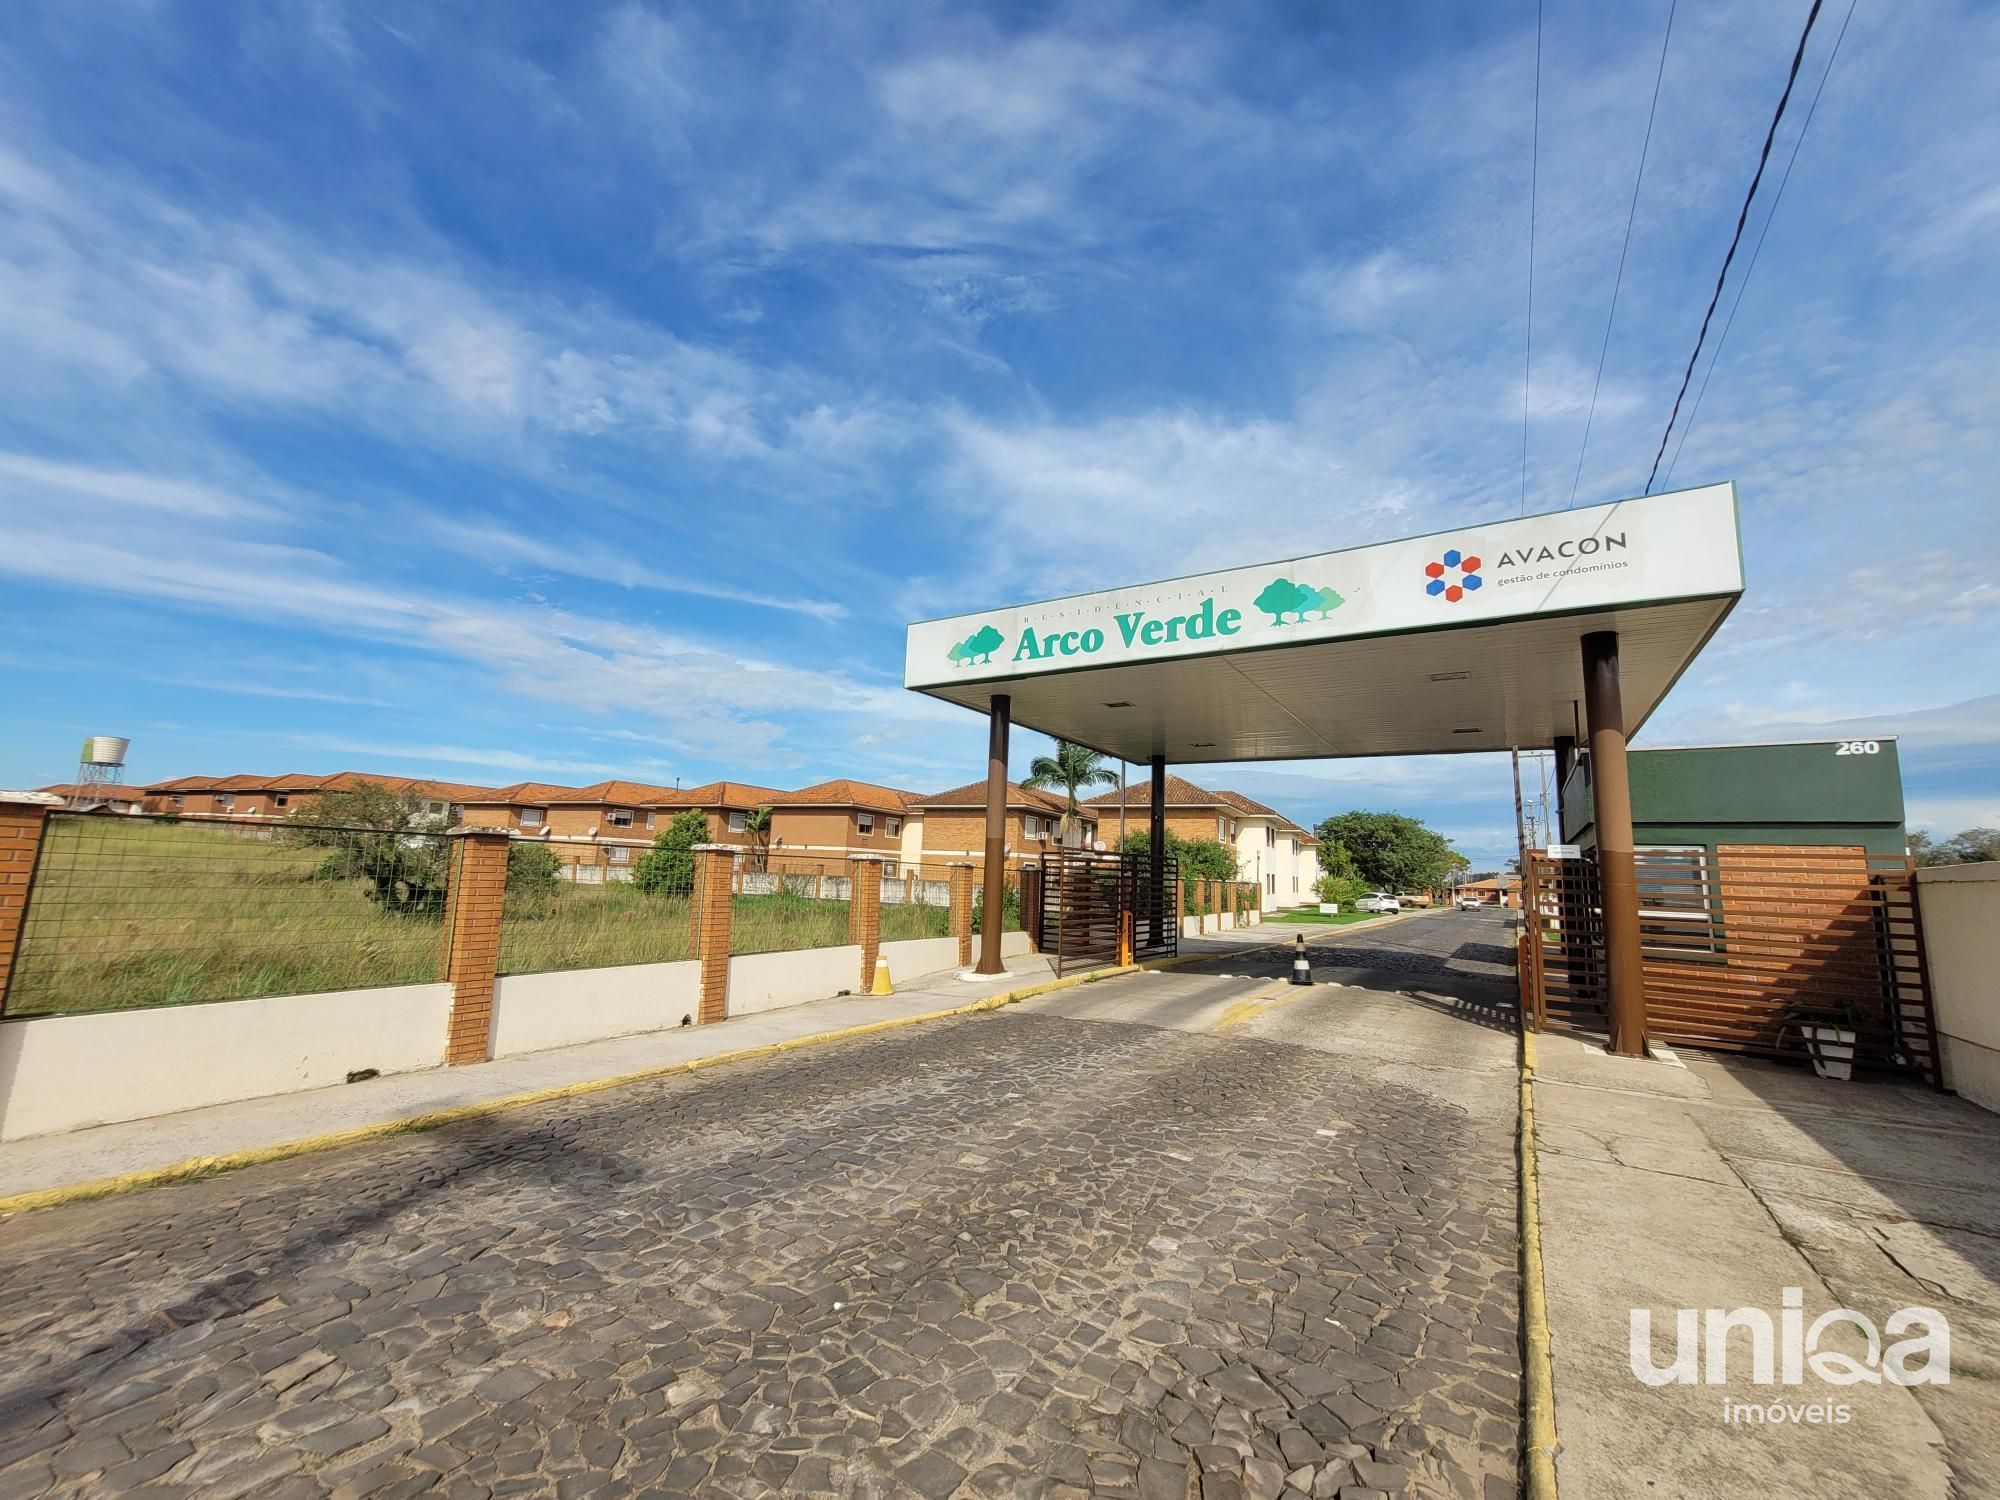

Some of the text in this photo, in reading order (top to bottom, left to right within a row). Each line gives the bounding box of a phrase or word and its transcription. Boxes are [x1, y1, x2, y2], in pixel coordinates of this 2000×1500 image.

[1497, 532, 1627, 569] AVACON
[1497, 575, 1534, 587] gestão
[1552, 561, 1629, 577] condomínios
[1012, 597, 1242, 662] Arco Verde
[1835, 741, 1880, 756] 260
